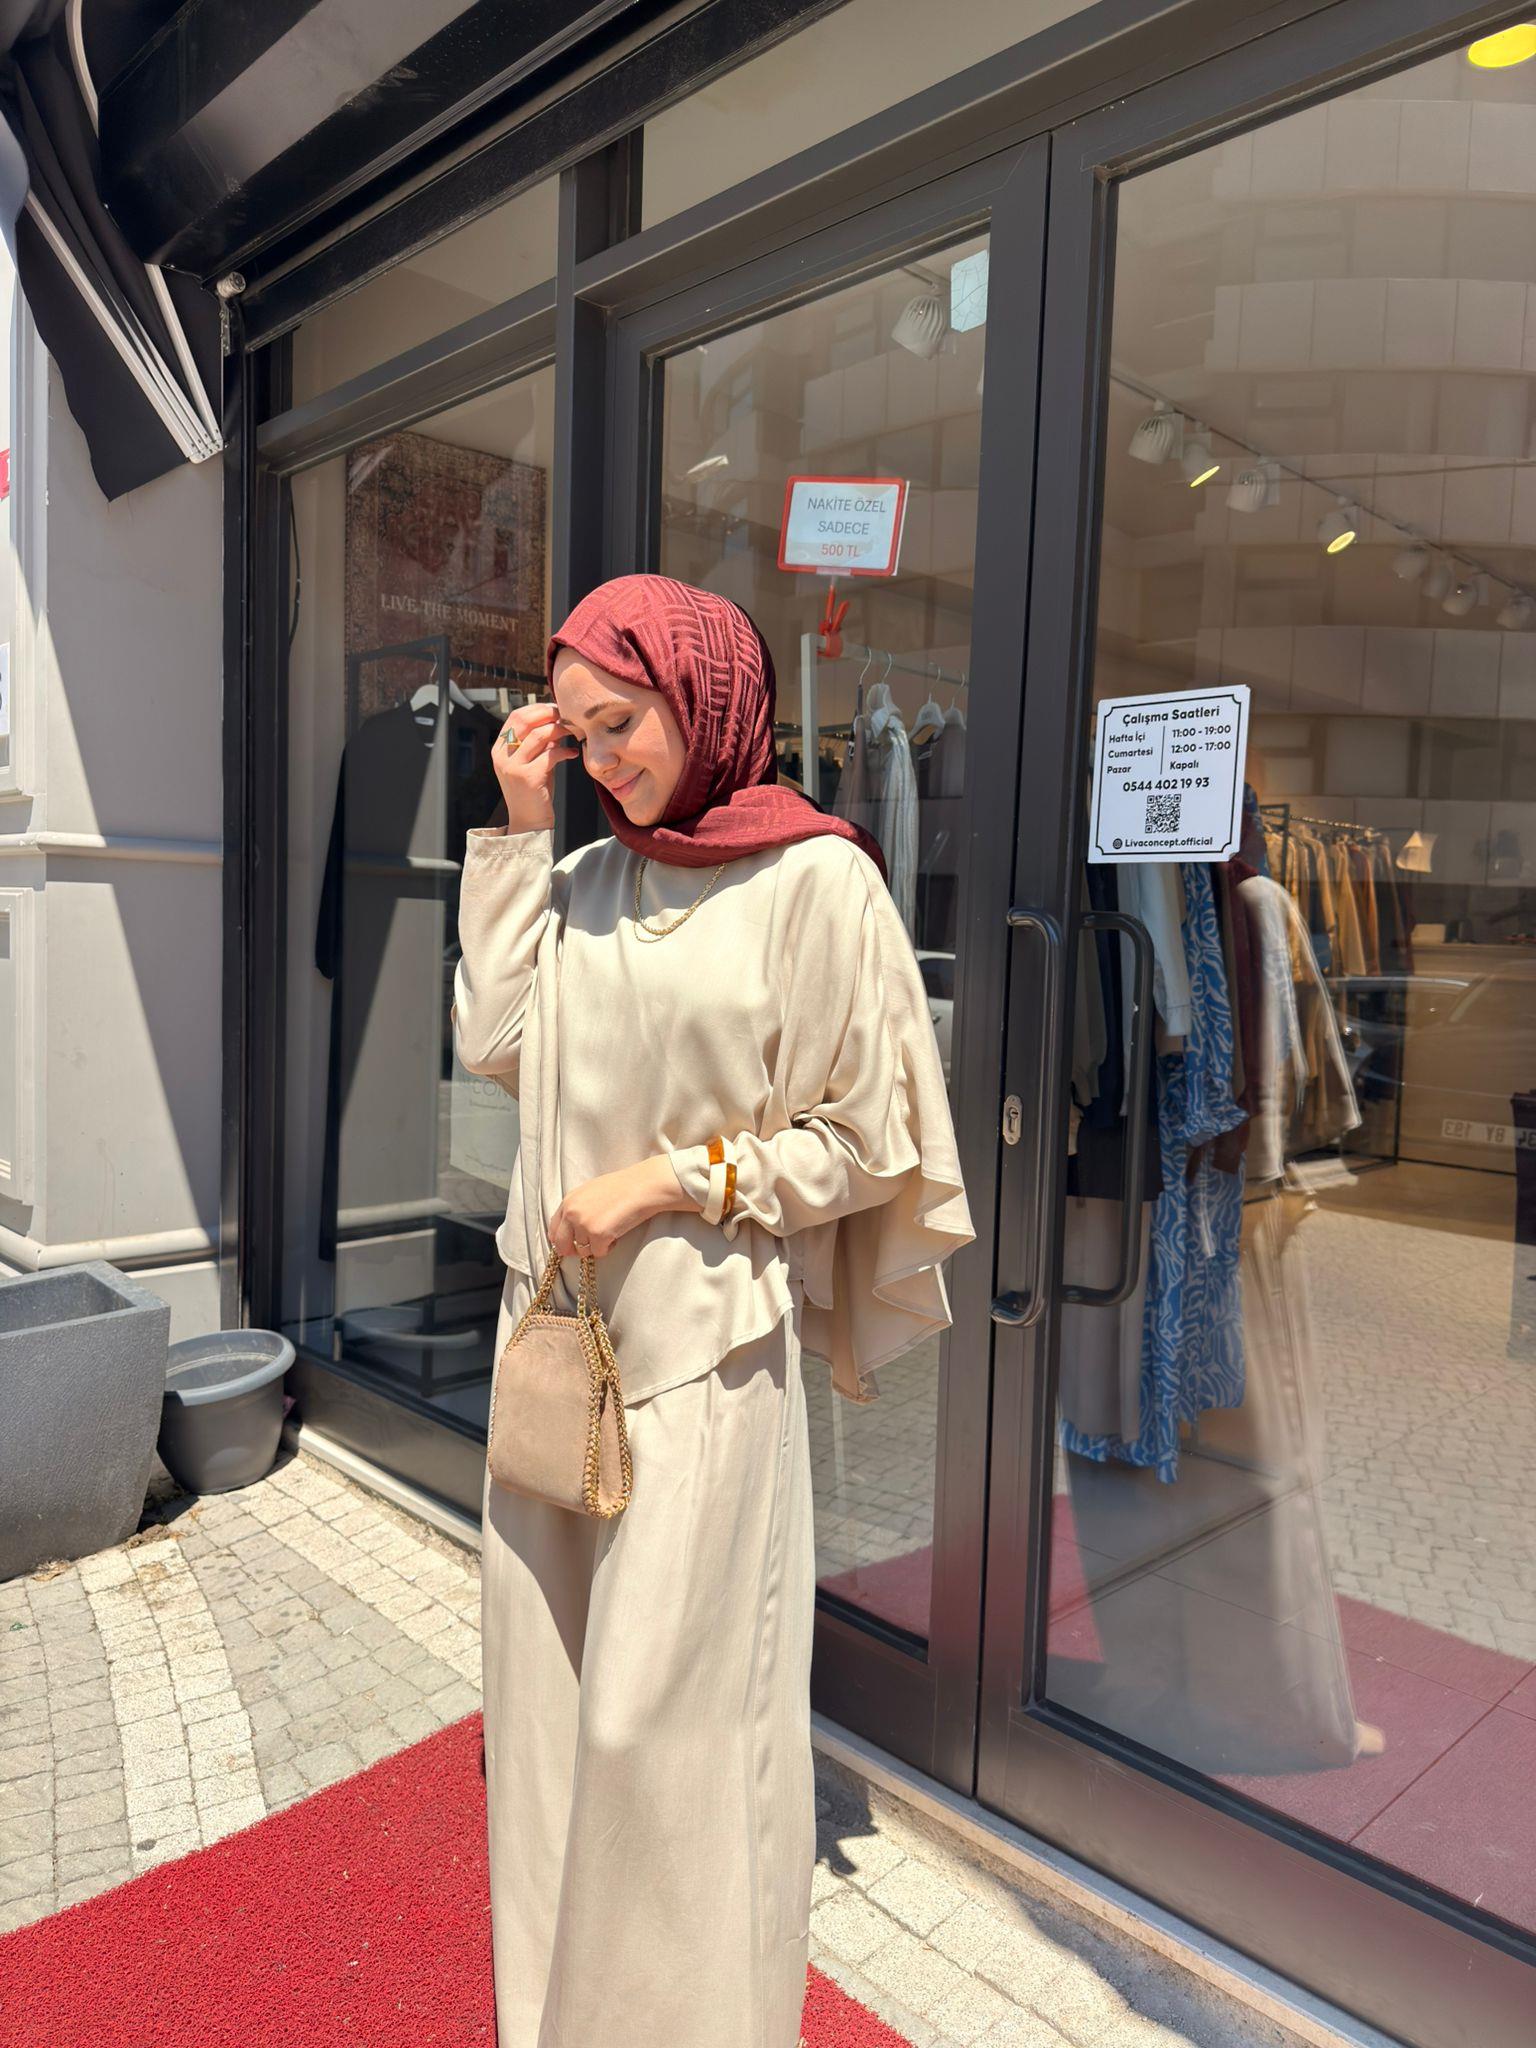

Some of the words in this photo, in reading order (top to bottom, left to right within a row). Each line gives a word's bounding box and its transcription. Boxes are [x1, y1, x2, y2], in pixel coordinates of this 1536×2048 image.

[807, 497, 851, 512] NAKİTE
[854, 498, 886, 513] ÖZEL
[817, 521, 870, 535] SADECE
[821, 543, 844, 556] 500
[846, 545, 860, 557] TL
[380, 593, 418, 613] LIVE
[421, 600, 451, 620] THE
[456, 607, 519, 632] MOMENT
[1122, 713, 1169, 728] Çalışma
[1171, 705, 1220, 720] Saatleri
[1108, 733, 1133, 744] Hafta
[1134, 731, 1146, 743] İçi
[1172, 727, 1196, 738] 11:00
[1204, 725, 1231, 736] 19:00
[1108, 747, 1153, 759] Cumartesi
[1171, 744, 1197, 754] 12:00
[1205, 741, 1231, 752] 17:00
[1106, 765, 1131, 774] Pazar
[1169, 760, 1199, 771] Kapalı
[1122, 780, 1152, 792] 0544
[1154, 779, 1178, 790] 402
[1180, 778, 1191, 789] 19
[1195, 777, 1210, 788] 93
[1124, 836, 1213, 848] Livaconcept.official
